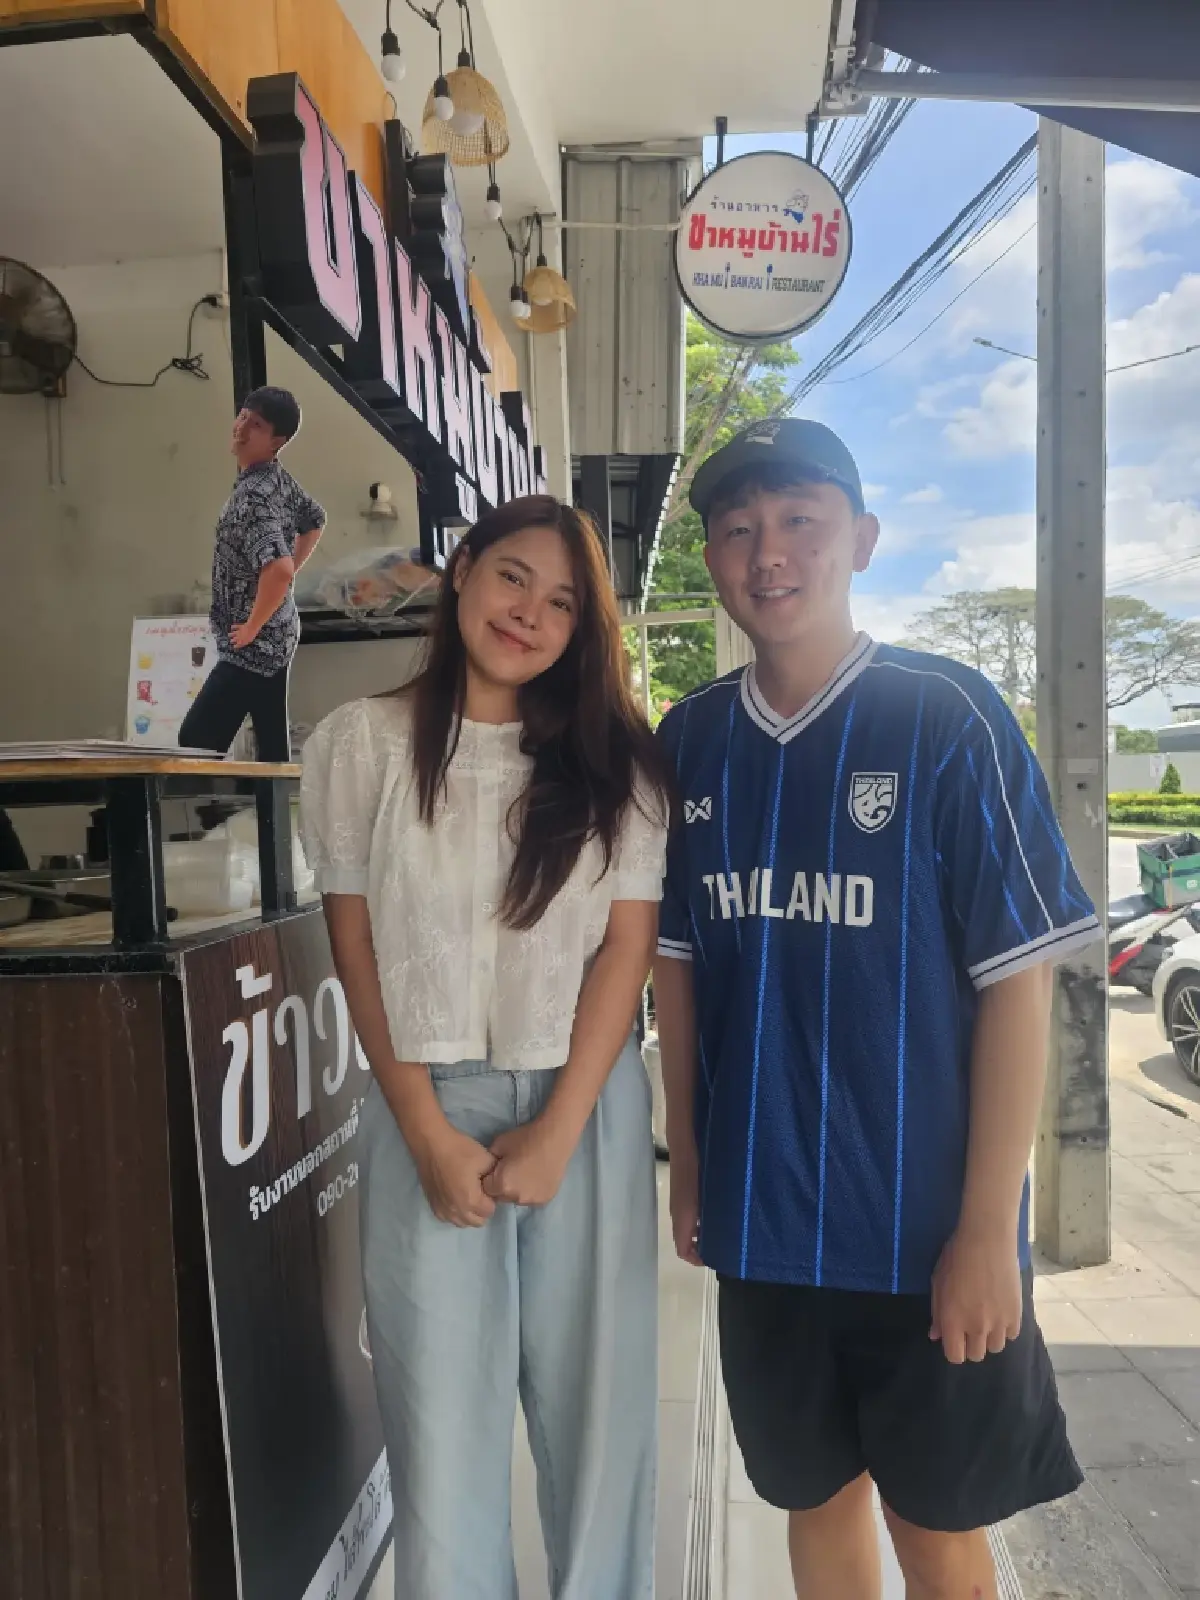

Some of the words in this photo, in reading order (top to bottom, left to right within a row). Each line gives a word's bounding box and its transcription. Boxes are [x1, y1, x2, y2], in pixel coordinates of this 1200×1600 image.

[711, 194, 778, 212] ร้านอาหาร
[688, 208, 842, 259] ขาหมูบ้านไร่
[702, 867, 874, 928] THILAND
[221, 963, 371, 1167] ข้าว
